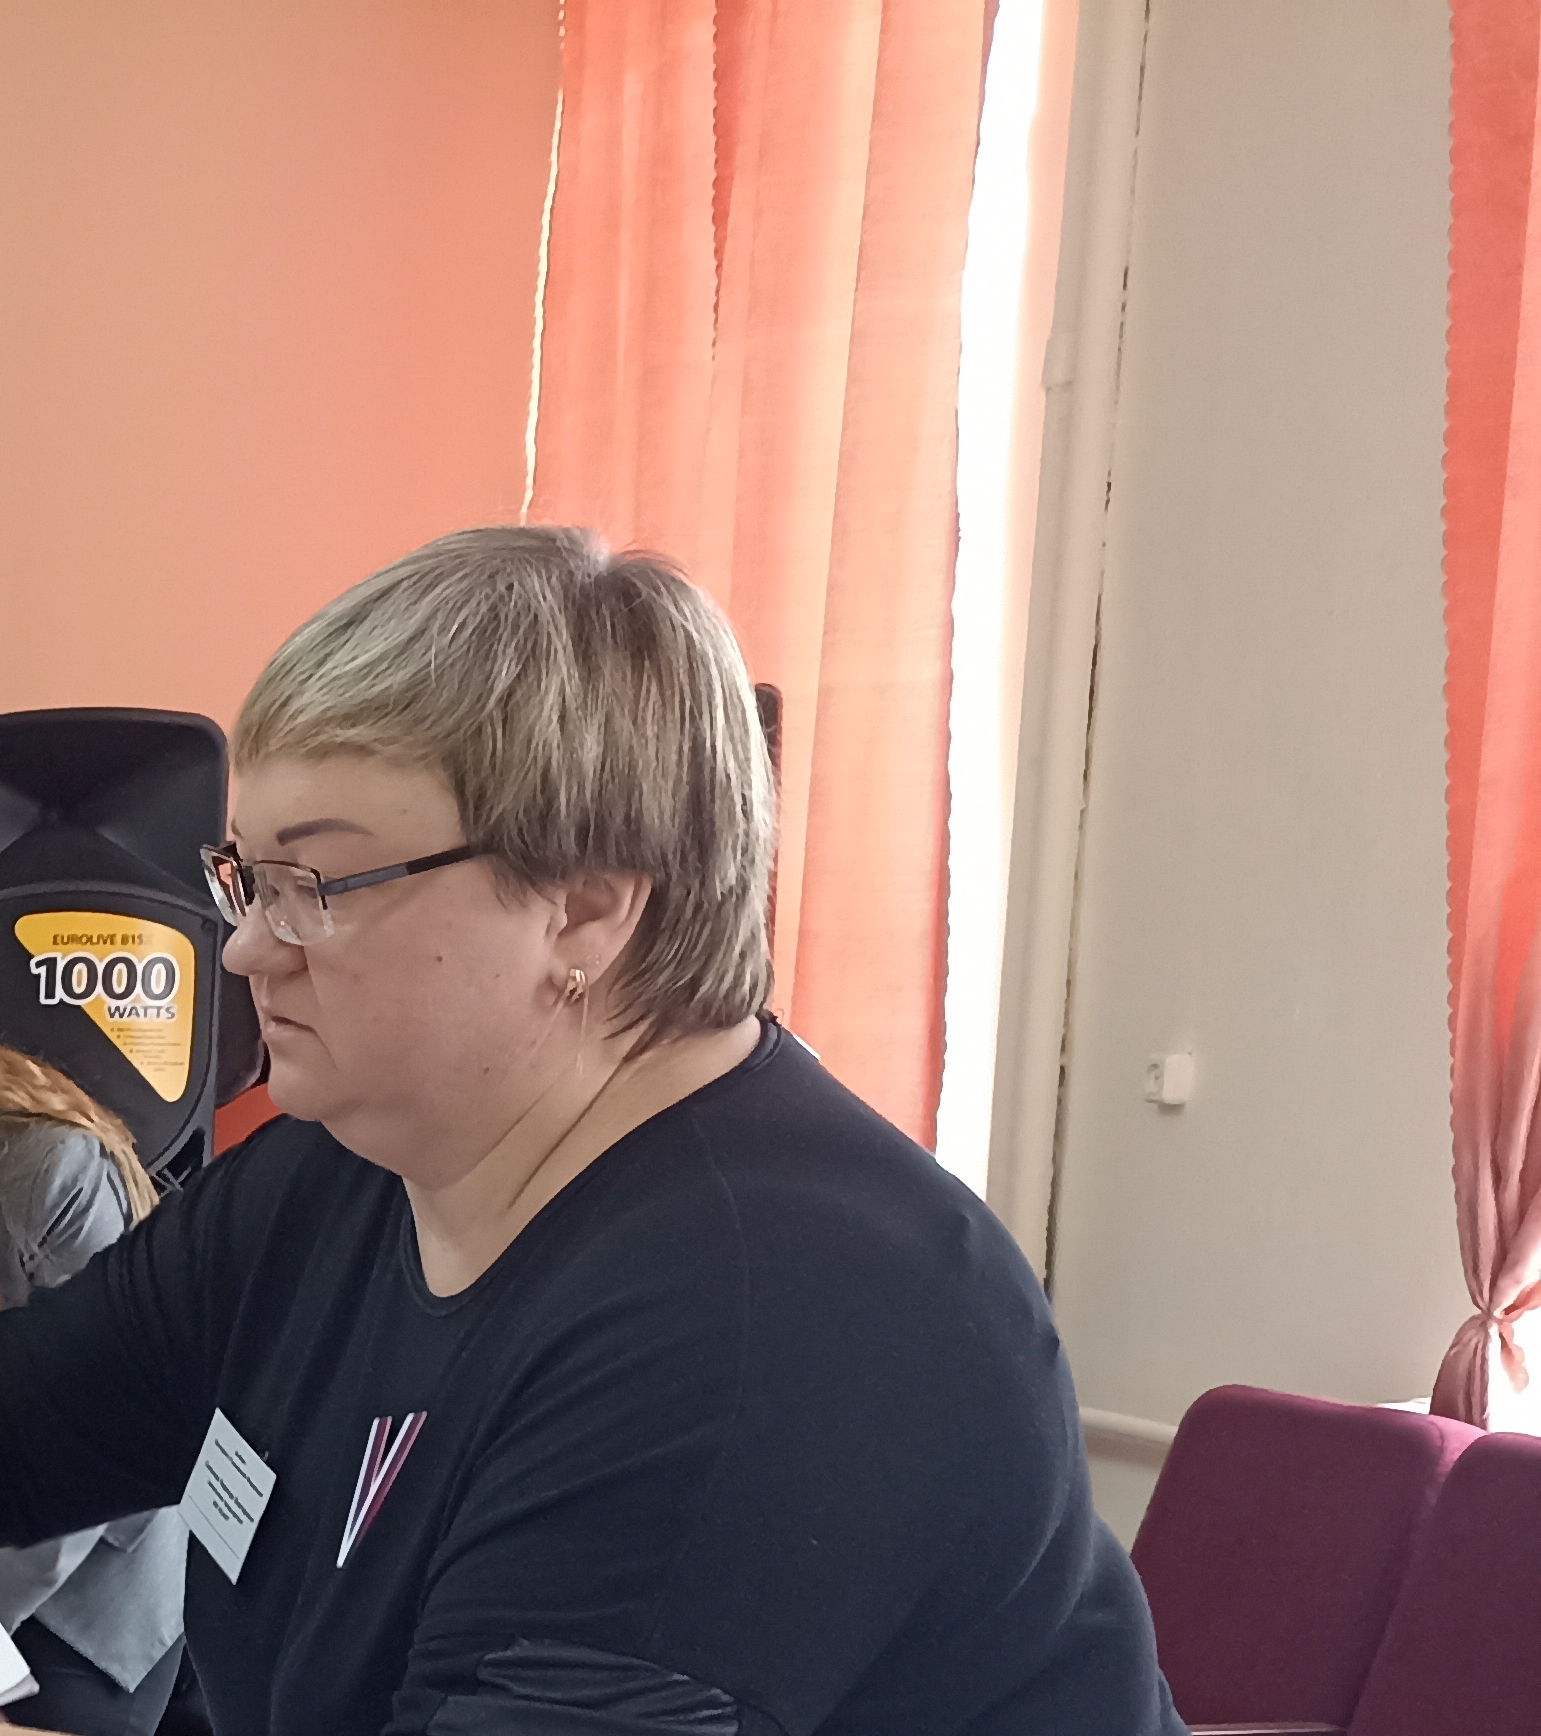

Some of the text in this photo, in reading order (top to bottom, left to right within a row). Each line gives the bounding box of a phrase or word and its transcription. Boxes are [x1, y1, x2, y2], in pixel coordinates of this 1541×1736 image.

[52, 933, 117, 946] EUROLIVE
[33, 954, 178, 1002] 1000
[107, 1005, 177, 1020] WATTS
